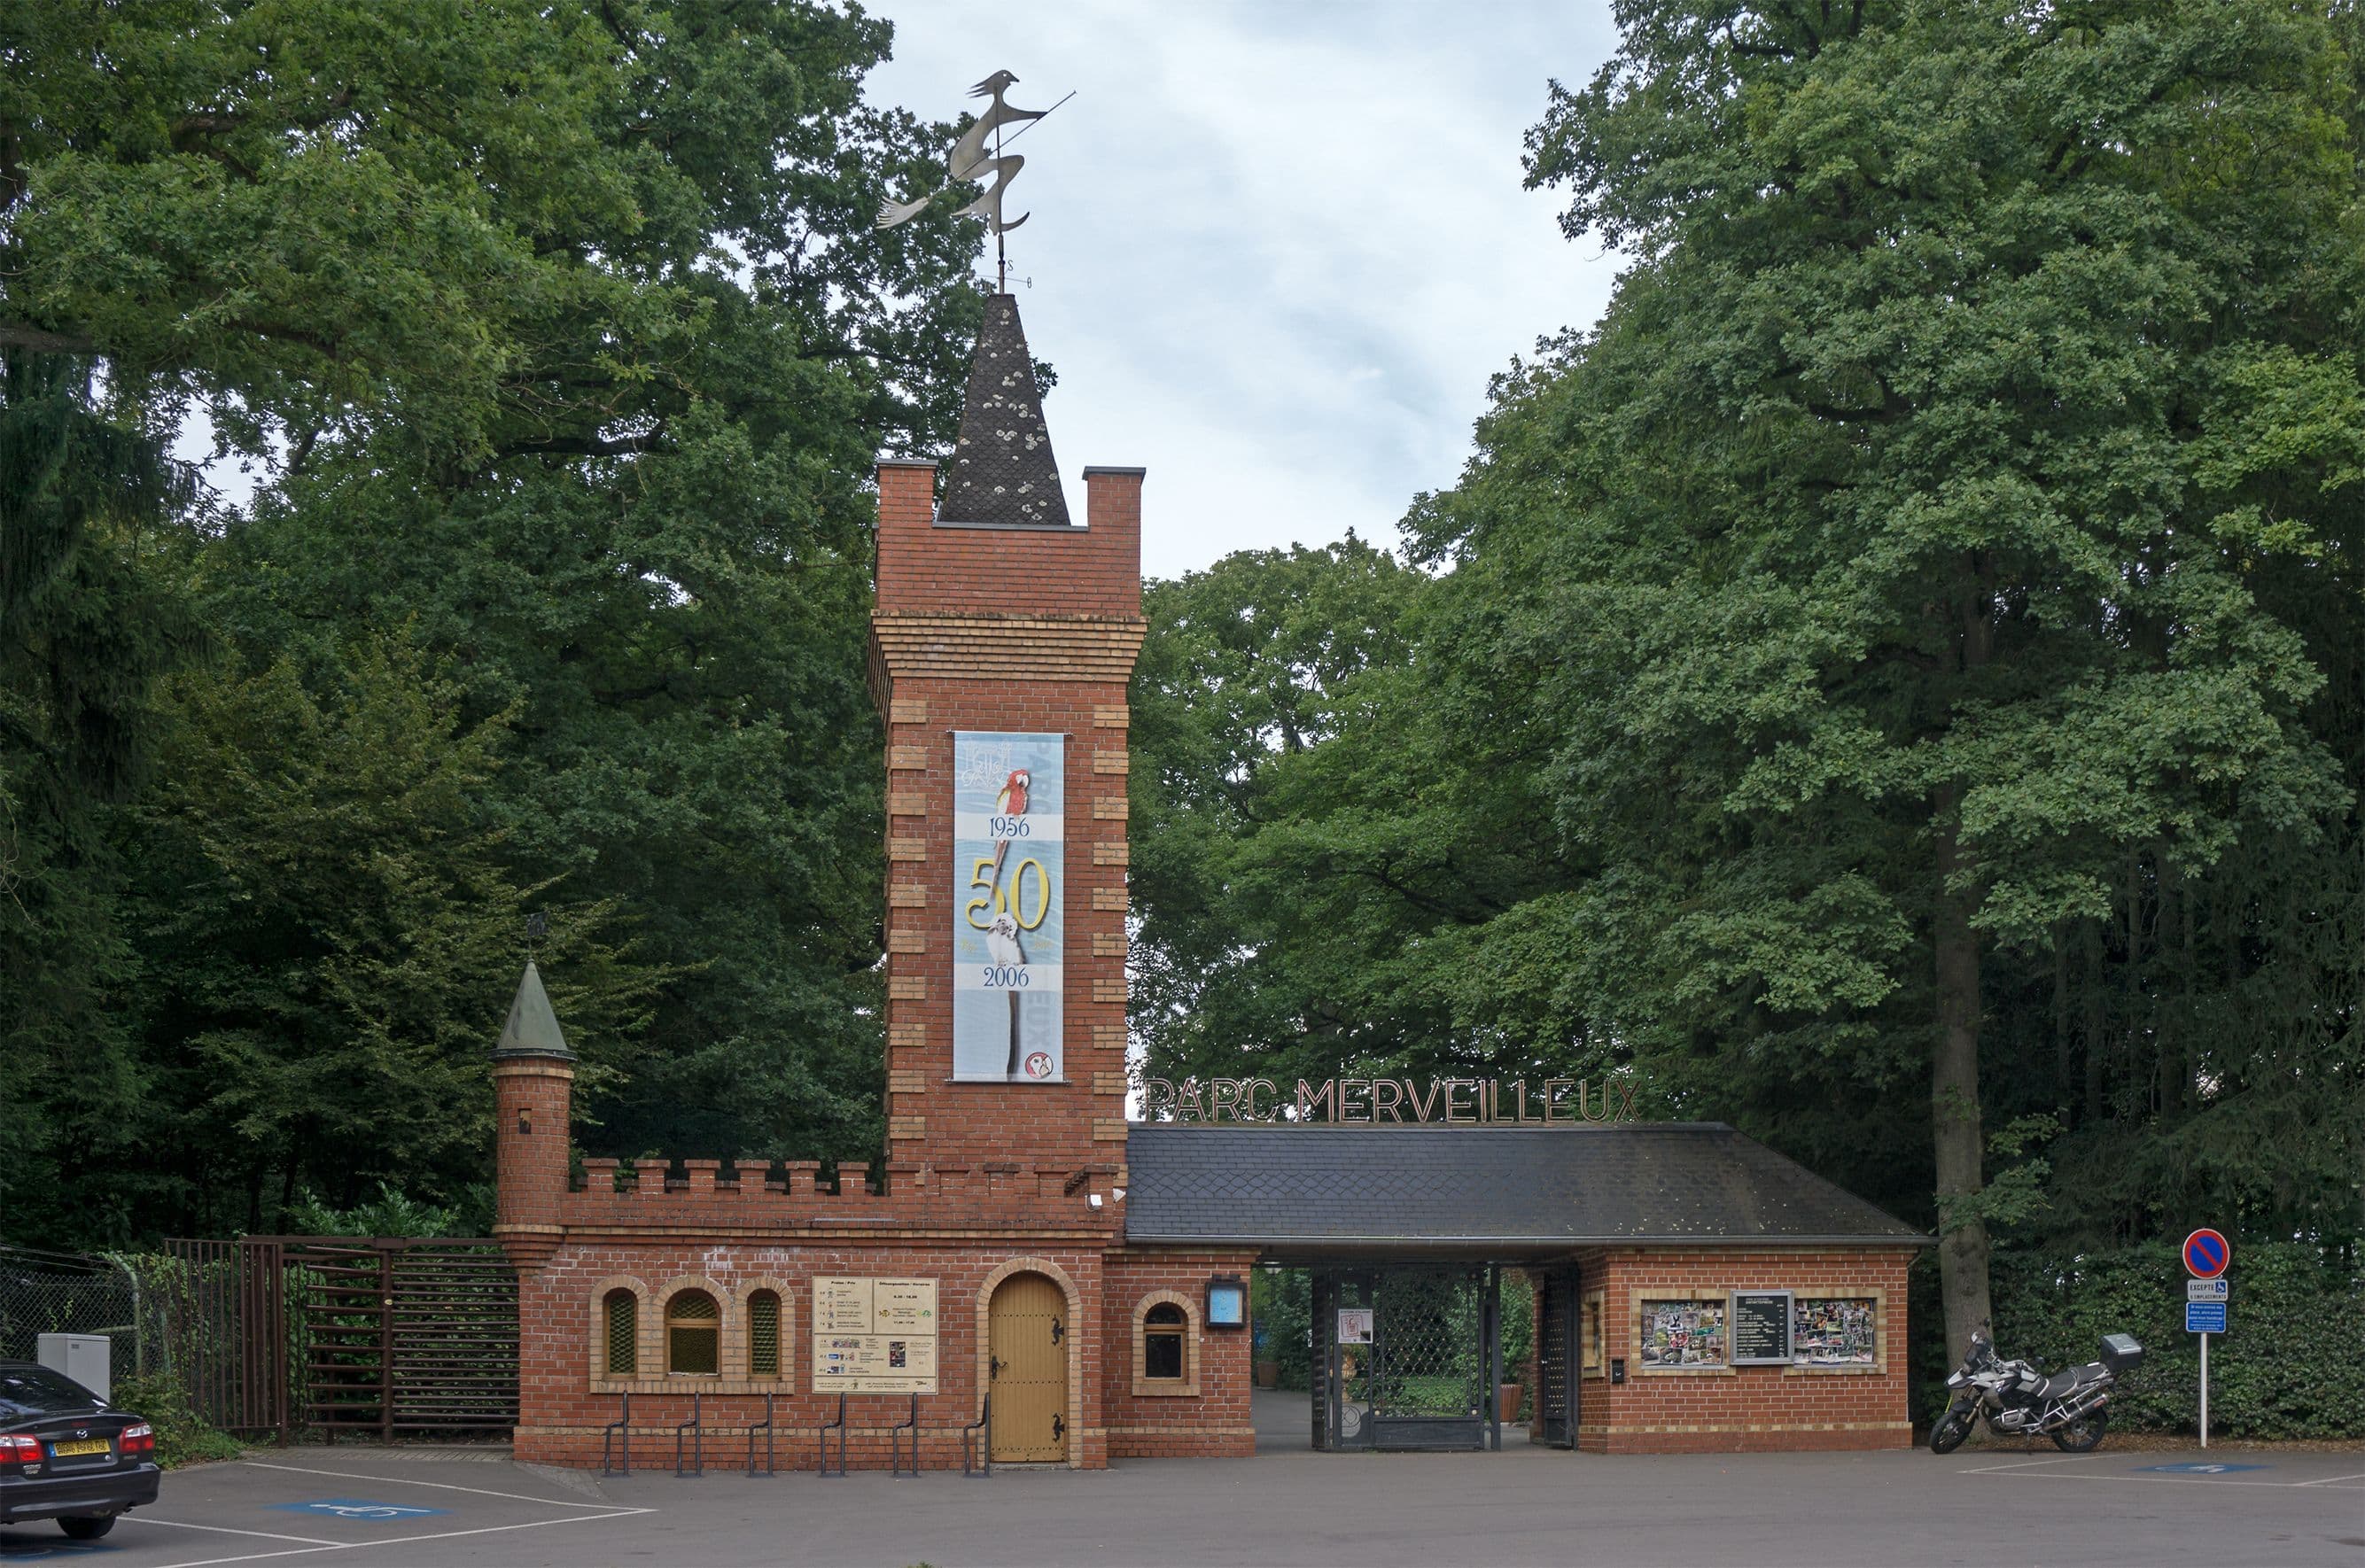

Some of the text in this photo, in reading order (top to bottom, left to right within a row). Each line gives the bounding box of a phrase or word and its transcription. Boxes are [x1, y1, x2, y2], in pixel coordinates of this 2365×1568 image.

[989, 816, 1031, 838] 1956
[965, 857, 1051, 931] 50
[983, 966, 1030, 988] 2006
[1145, 1077, 1640, 1123] PARC MERVEILLEUX
